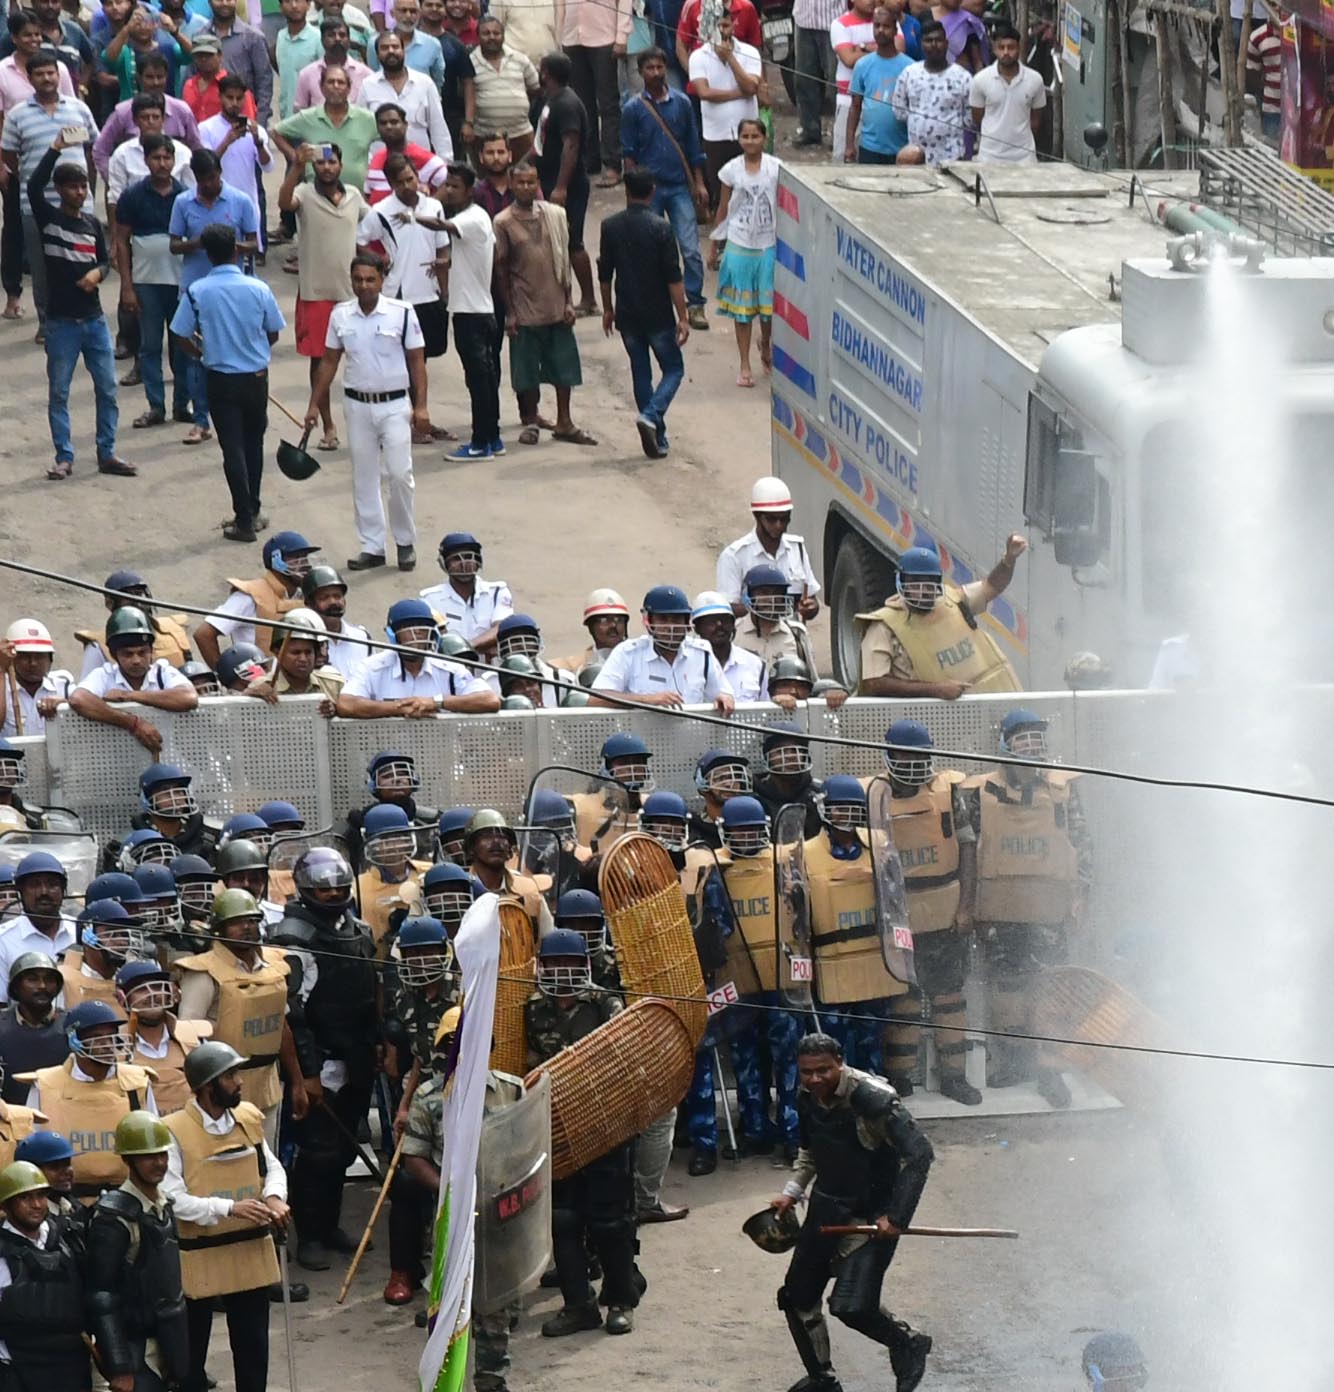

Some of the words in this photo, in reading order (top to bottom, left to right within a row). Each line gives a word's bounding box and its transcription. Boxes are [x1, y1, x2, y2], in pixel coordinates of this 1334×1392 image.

[836, 225, 875, 285] WATER
[877, 265, 925, 327] CANNON
[831, 312, 922, 413] BIDHANNAGAR
[829, 393, 861, 439] CITY
[866, 424, 918, 494] POLICE
[899, 845, 939, 868] OLICE
[733, 897, 770, 918] OLICE
[707, 984, 739, 1014] ICE
